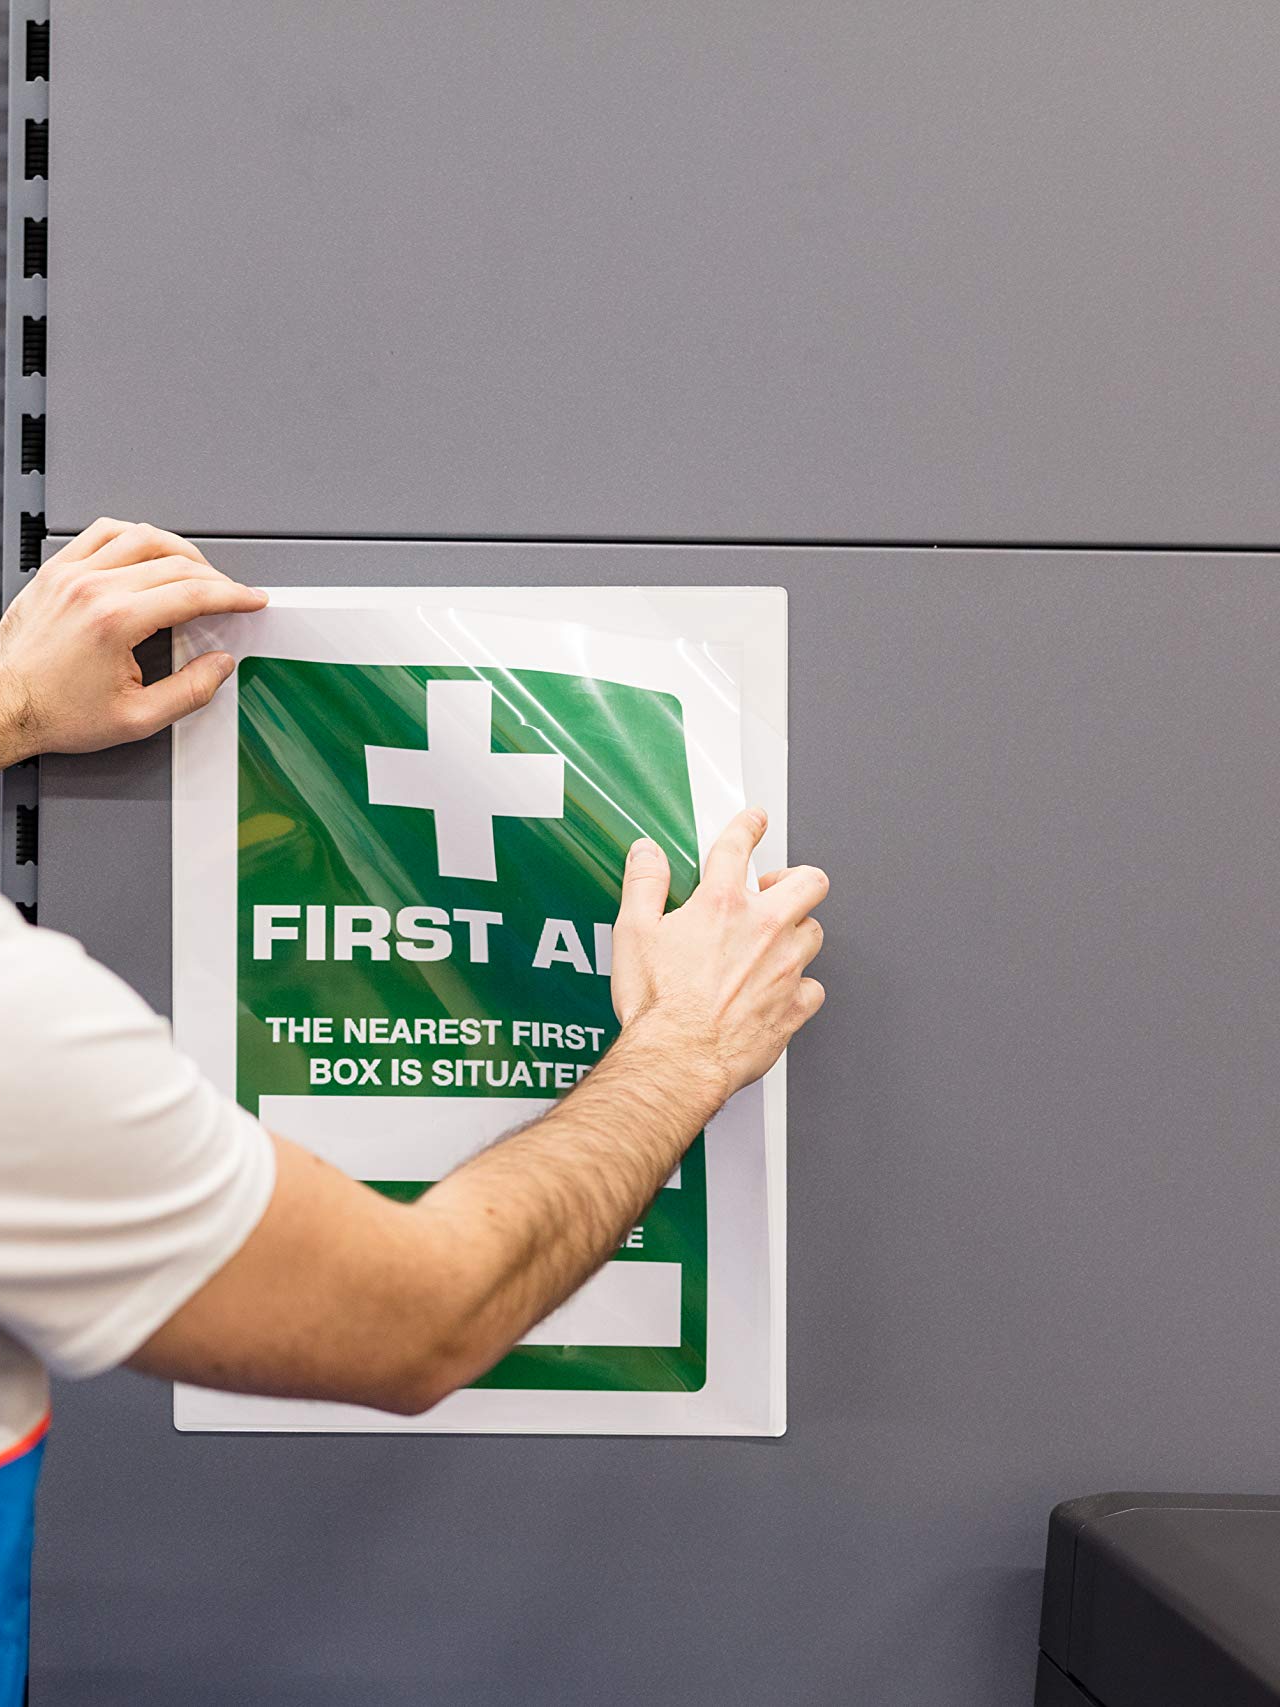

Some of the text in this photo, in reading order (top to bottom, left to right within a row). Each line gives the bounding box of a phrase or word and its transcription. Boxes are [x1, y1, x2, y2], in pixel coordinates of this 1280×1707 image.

[252, 904, 613, 977] FIRST AI
[265, 1016, 606, 1052] THE NEAREST FIRST
[309, 1058, 382, 1086] BOX
[390, 1058, 423, 1086] IS
